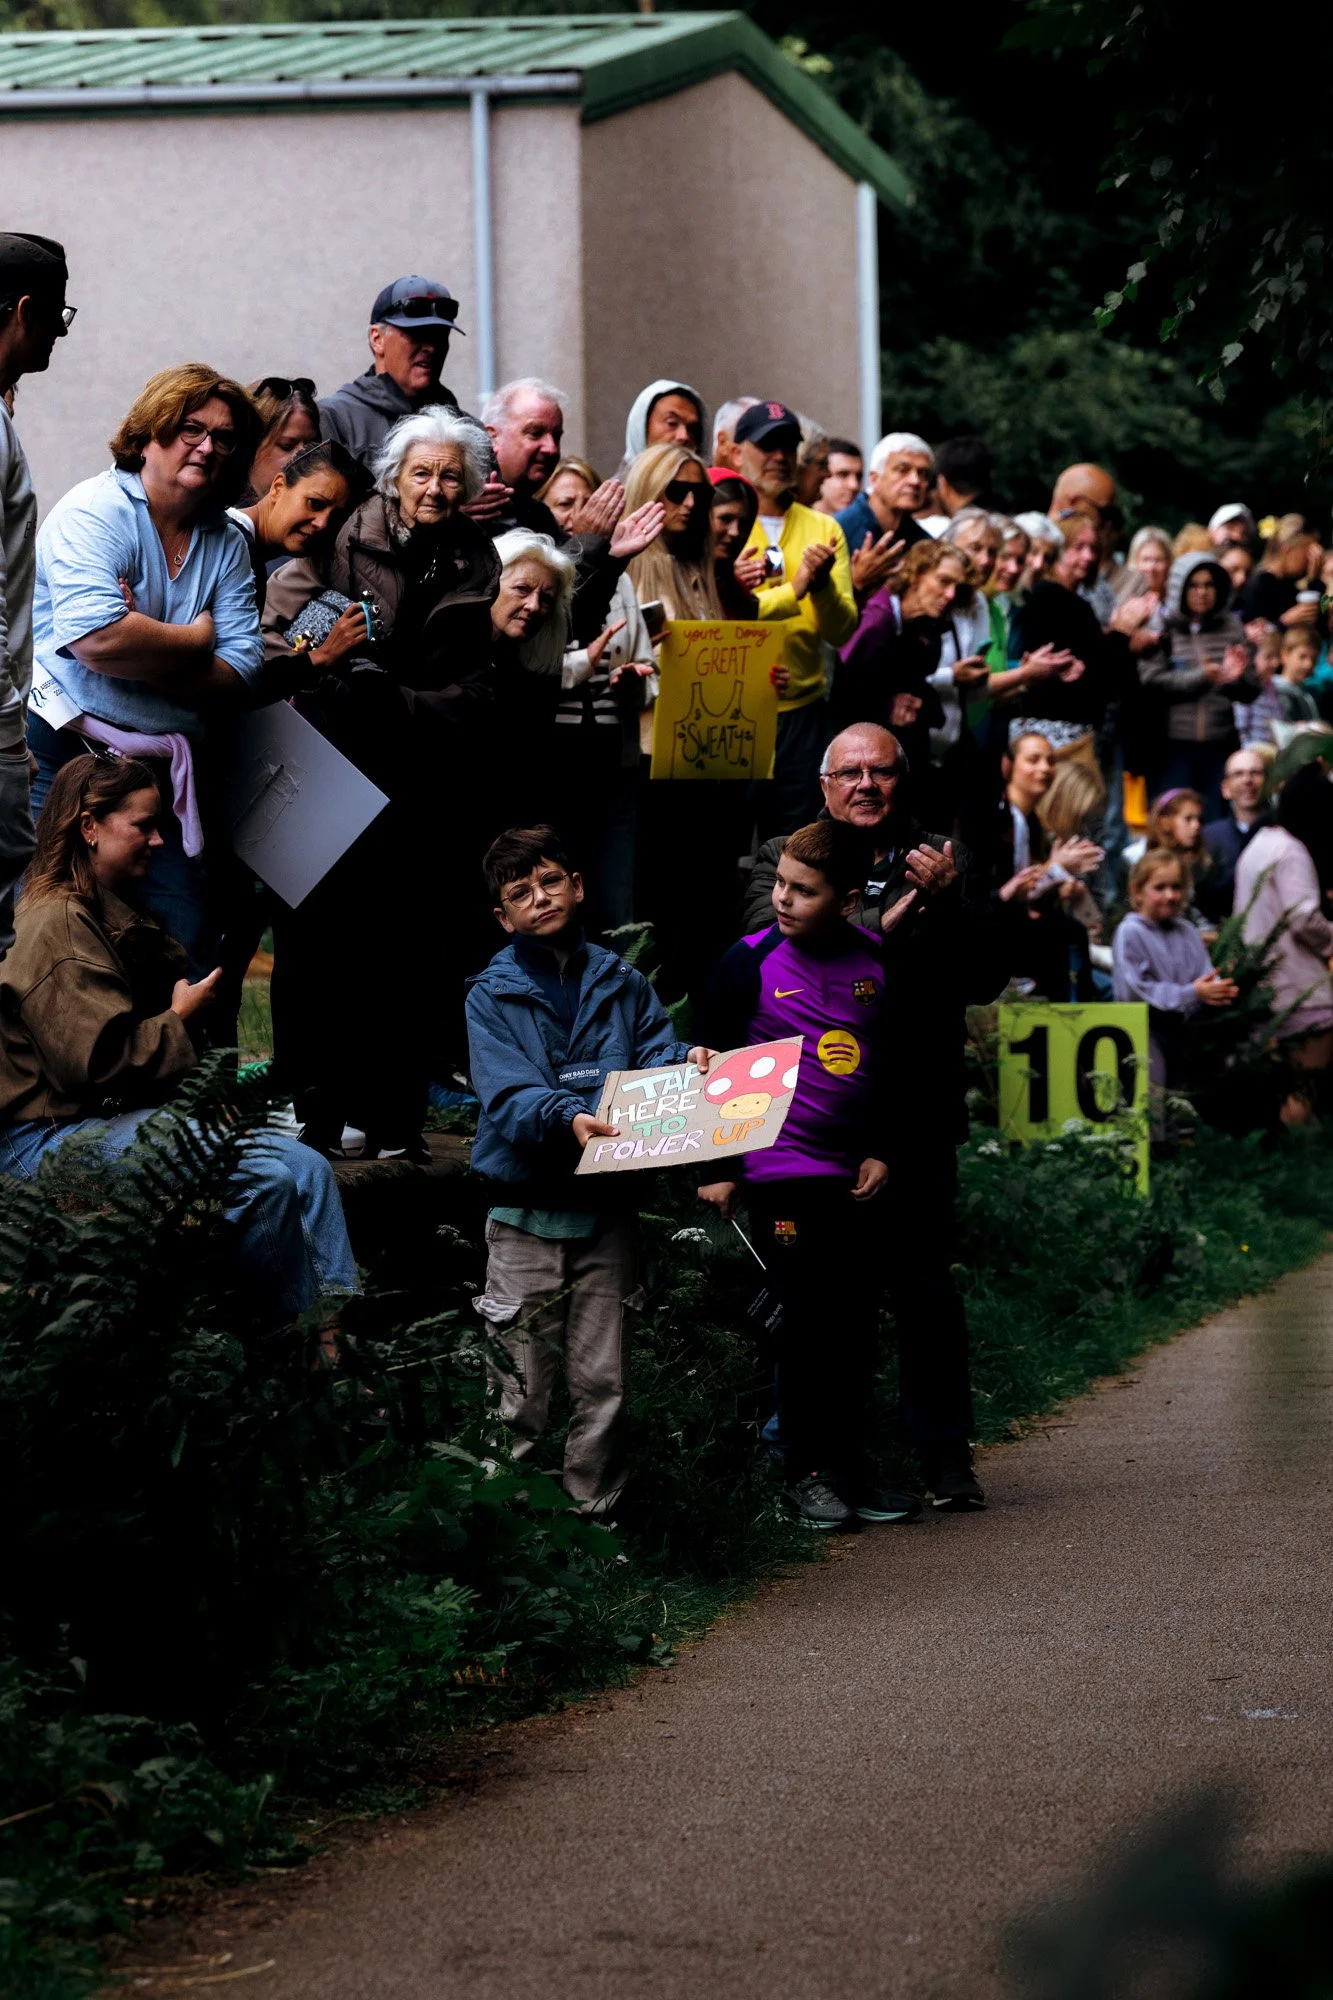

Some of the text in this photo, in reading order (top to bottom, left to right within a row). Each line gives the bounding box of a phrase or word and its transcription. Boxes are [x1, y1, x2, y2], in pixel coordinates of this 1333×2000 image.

[696, 646, 751, 676] GREAT
[682, 722, 745, 765] SWEATY
[559, 1072, 573, 1080] ONLY
[621, 1064, 702, 1100] TAP
[1010, 1025, 1138, 1123] 10
[612, 1088, 702, 1124] HERE
[593, 1117, 765, 1162] POWER UP
[632, 1115, 688, 1137] TO
